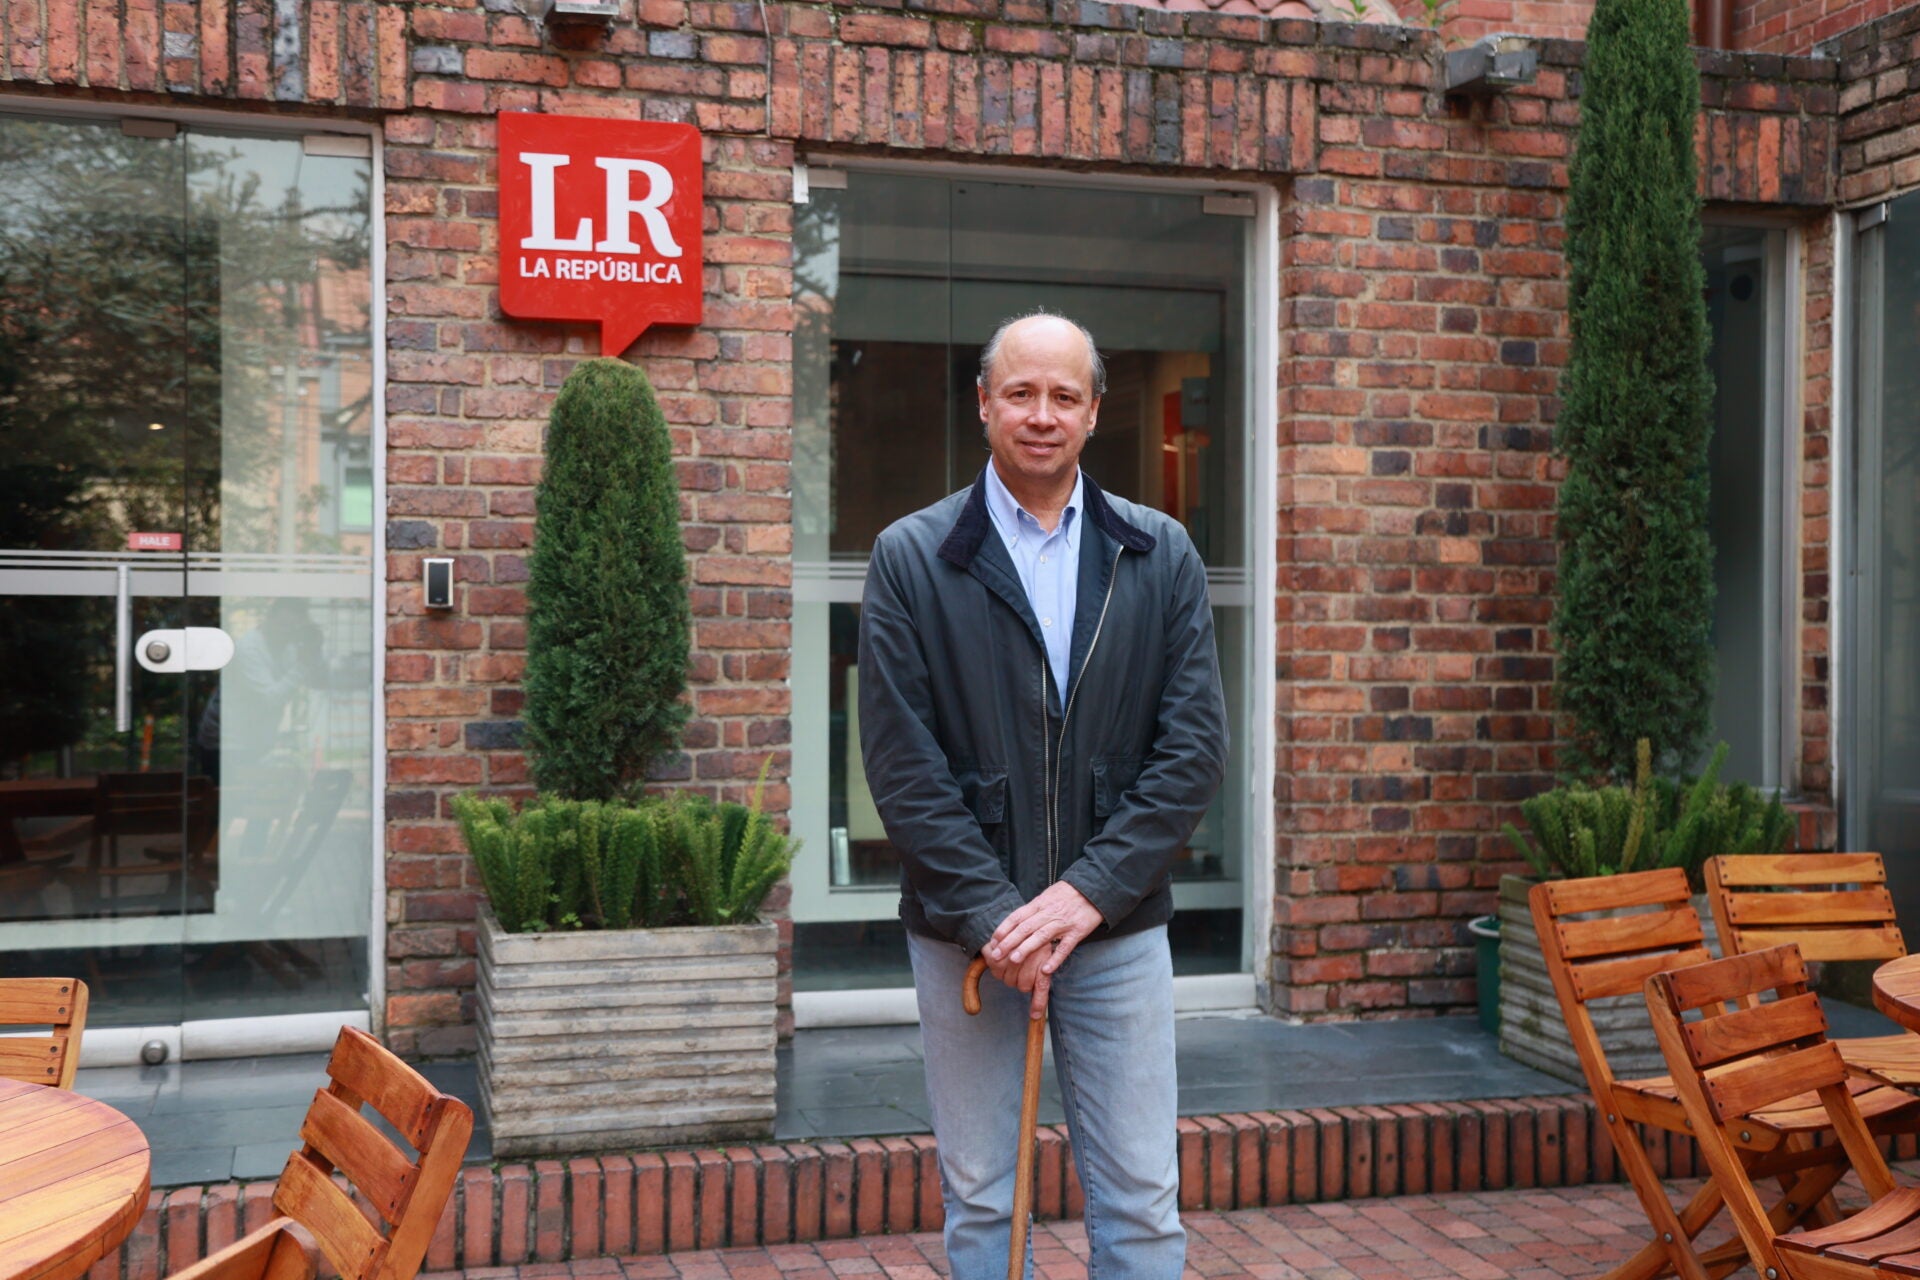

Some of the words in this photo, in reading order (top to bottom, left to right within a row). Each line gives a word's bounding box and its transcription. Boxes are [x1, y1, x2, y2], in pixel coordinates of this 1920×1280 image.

[519, 152, 683, 257] LR
[519, 256, 550, 279] LA
[555, 257, 683, 285] REPÚBLICA
[138, 536, 171, 546] HALE
